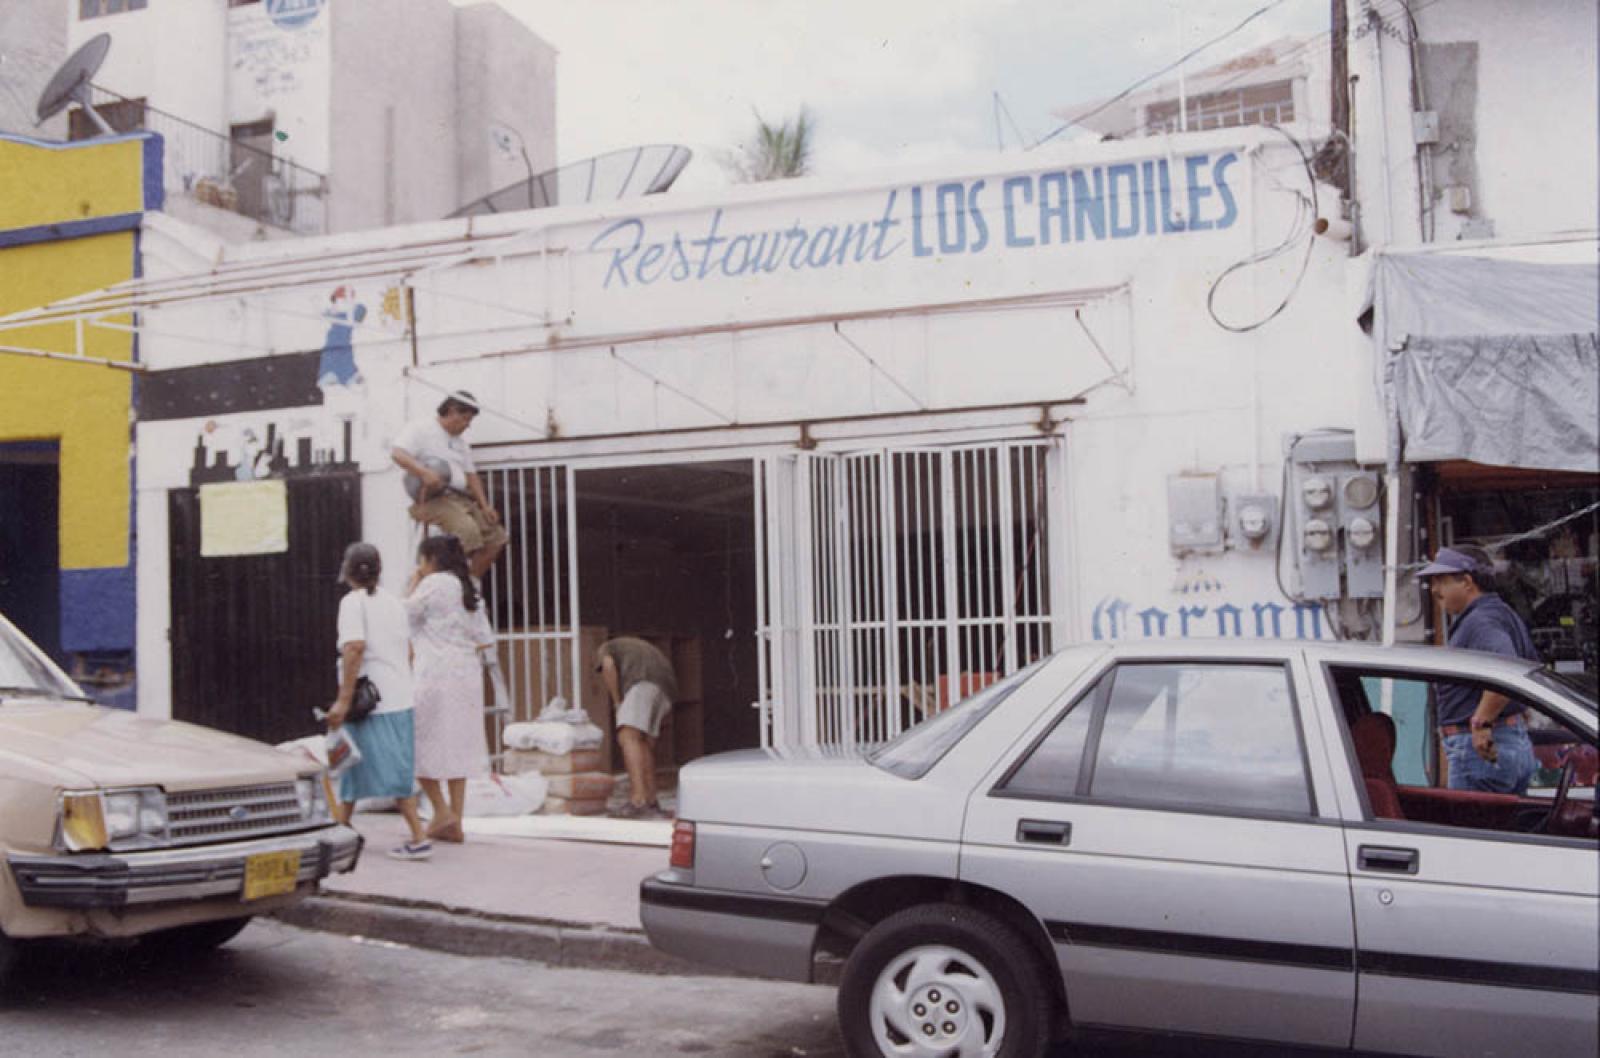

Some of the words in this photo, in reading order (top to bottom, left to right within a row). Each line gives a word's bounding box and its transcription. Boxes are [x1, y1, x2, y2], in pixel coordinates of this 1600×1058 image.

[590, 189, 906, 289] Restaurant
[911, 179, 989, 257] LOS
[1003, 152, 1238, 249] CANDILES
